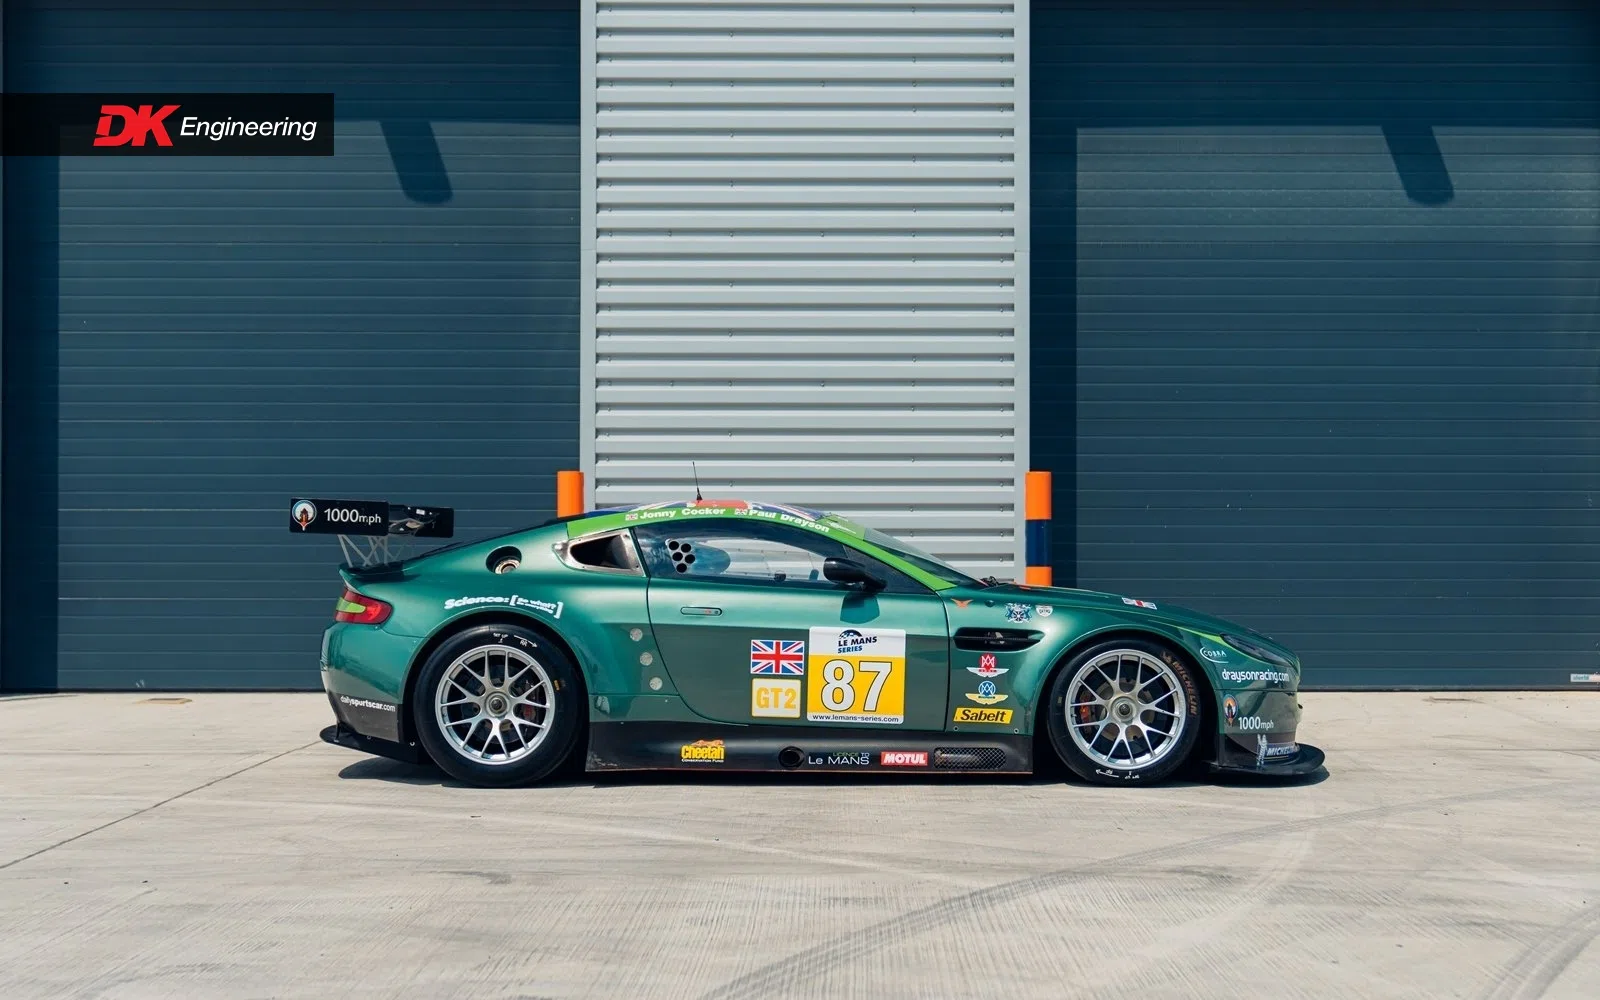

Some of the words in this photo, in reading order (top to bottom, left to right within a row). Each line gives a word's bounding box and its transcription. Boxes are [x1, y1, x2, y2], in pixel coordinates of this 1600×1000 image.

[324, 508, 381, 526] 1000mph
[639, 509, 676, 520] Jonny
[681, 507, 726, 516] Cocker
[748, 509, 777, 519] Paul
[781, 513, 830, 533] Drayson
[850, 635, 877, 646] MANS
[838, 645, 863, 654] SERIES
[1203, 650, 1227, 658] COBRA
[1222, 669, 1290, 683] draysonracing.com
[821, 659, 892, 712] 87
[340, 695, 396, 712] dailysportscar.com
[756, 687, 797, 709] GT2
[812, 714, 899, 723] www.lemans-series.com
[960, 709, 1007, 722] Sabelt
[1238, 716, 1274, 731] 1000mph
[681, 745, 725, 760] Cheetah
[883, 753, 926, 764] MOTUL
[808, 756, 823, 765] Le
[828, 756, 870, 765] MANS
